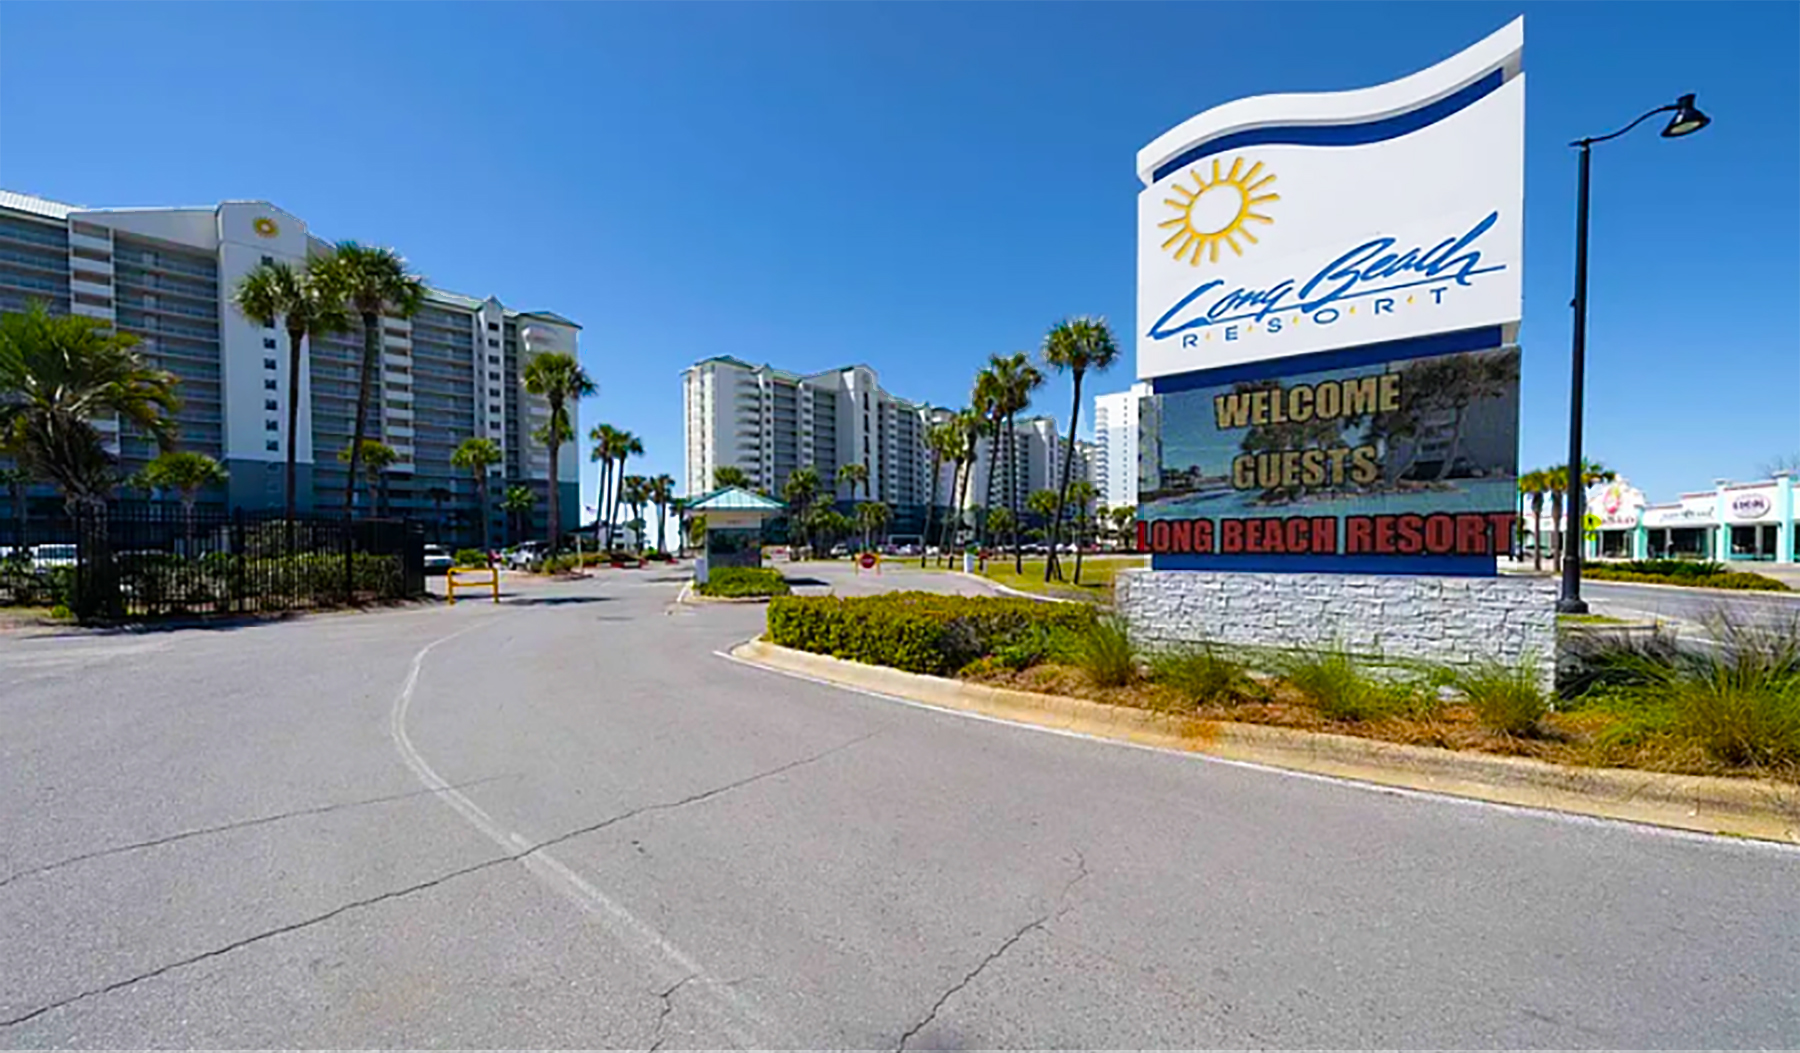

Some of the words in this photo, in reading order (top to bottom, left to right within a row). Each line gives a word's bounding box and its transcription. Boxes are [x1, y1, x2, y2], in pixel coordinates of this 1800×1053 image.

[1146, 279, 1295, 340] Long
[1299, 211, 1501, 313] Beach
[1214, 373, 1402, 430] WELCOME
[1231, 444, 1378, 490] GUESTS
[1136, 519, 1213, 553] LONG
[1221, 516, 1338, 553] BEACH
[1346, 512, 1517, 553] RESORT
